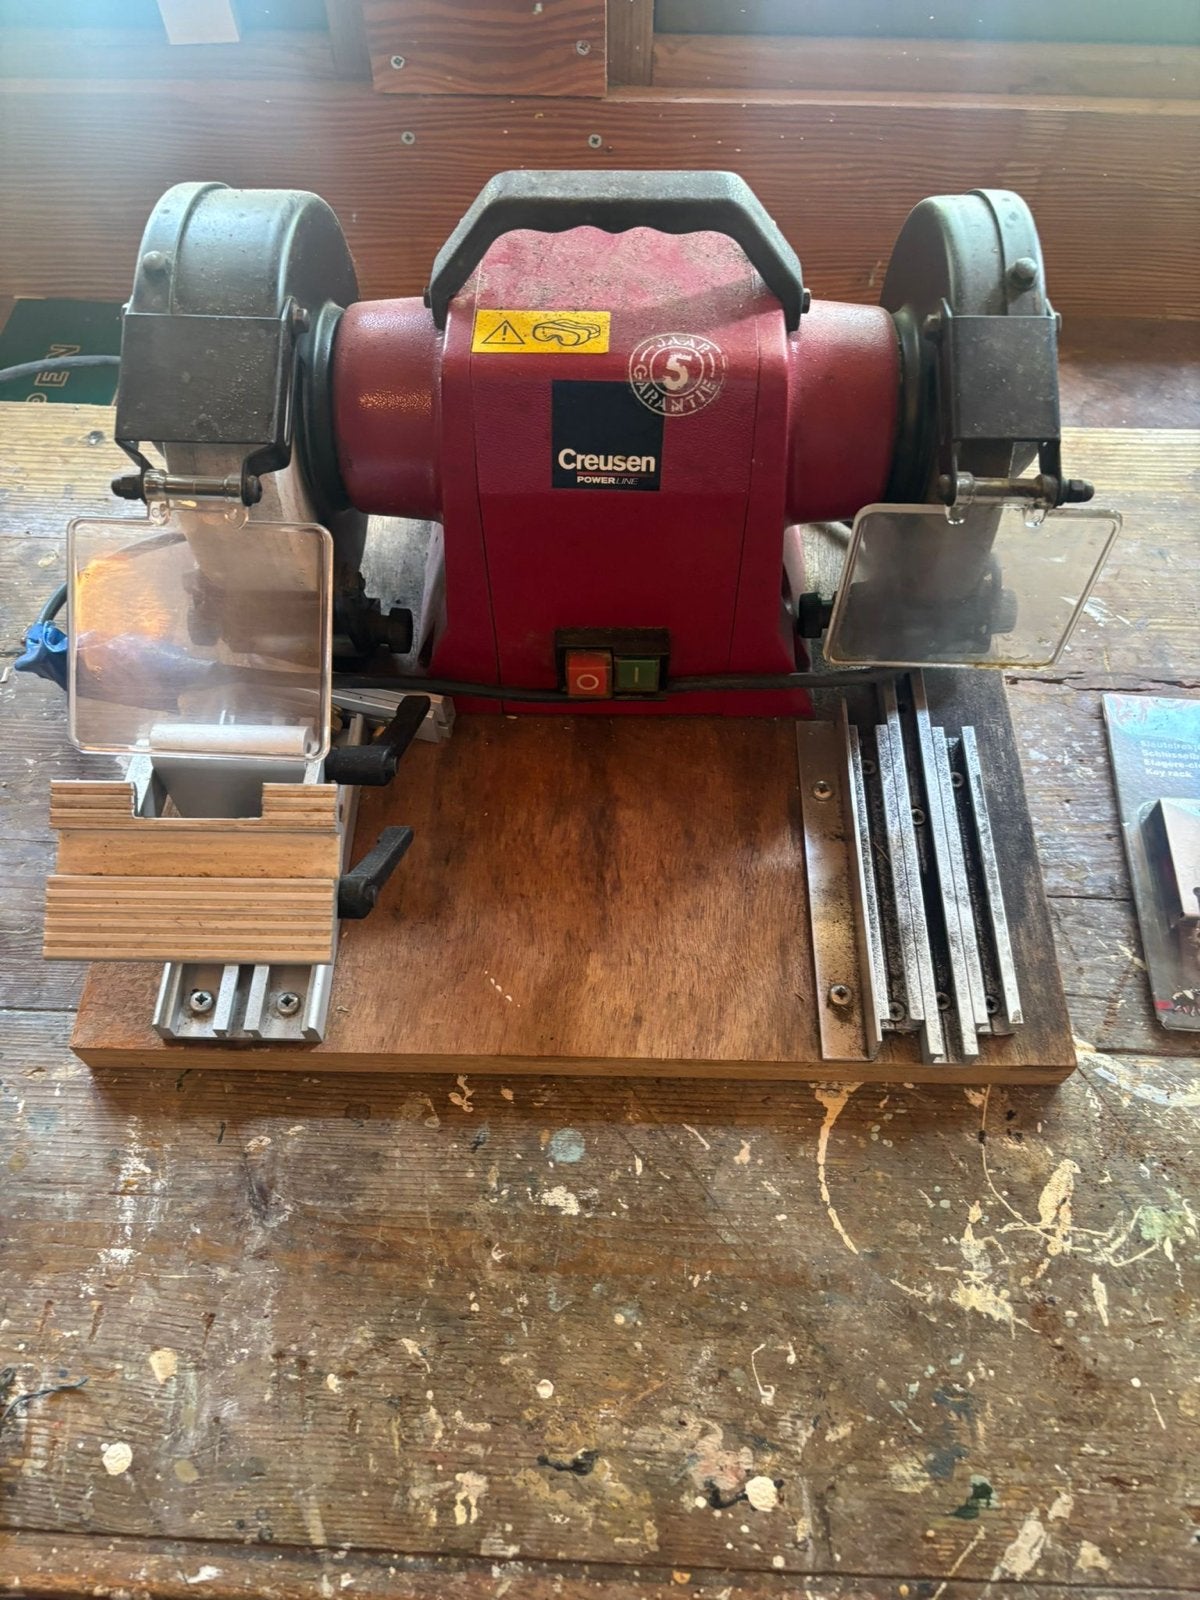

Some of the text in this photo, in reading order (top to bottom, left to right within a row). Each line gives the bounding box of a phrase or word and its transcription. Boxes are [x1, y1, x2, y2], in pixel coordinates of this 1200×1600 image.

[657, 336, 711, 353] JAAR
[662, 352, 693, 391] 5
[633, 364, 717, 412] GARANTIE
[558, 448, 656, 472] Creusen
[1145, 768, 1193, 778] Key rack
